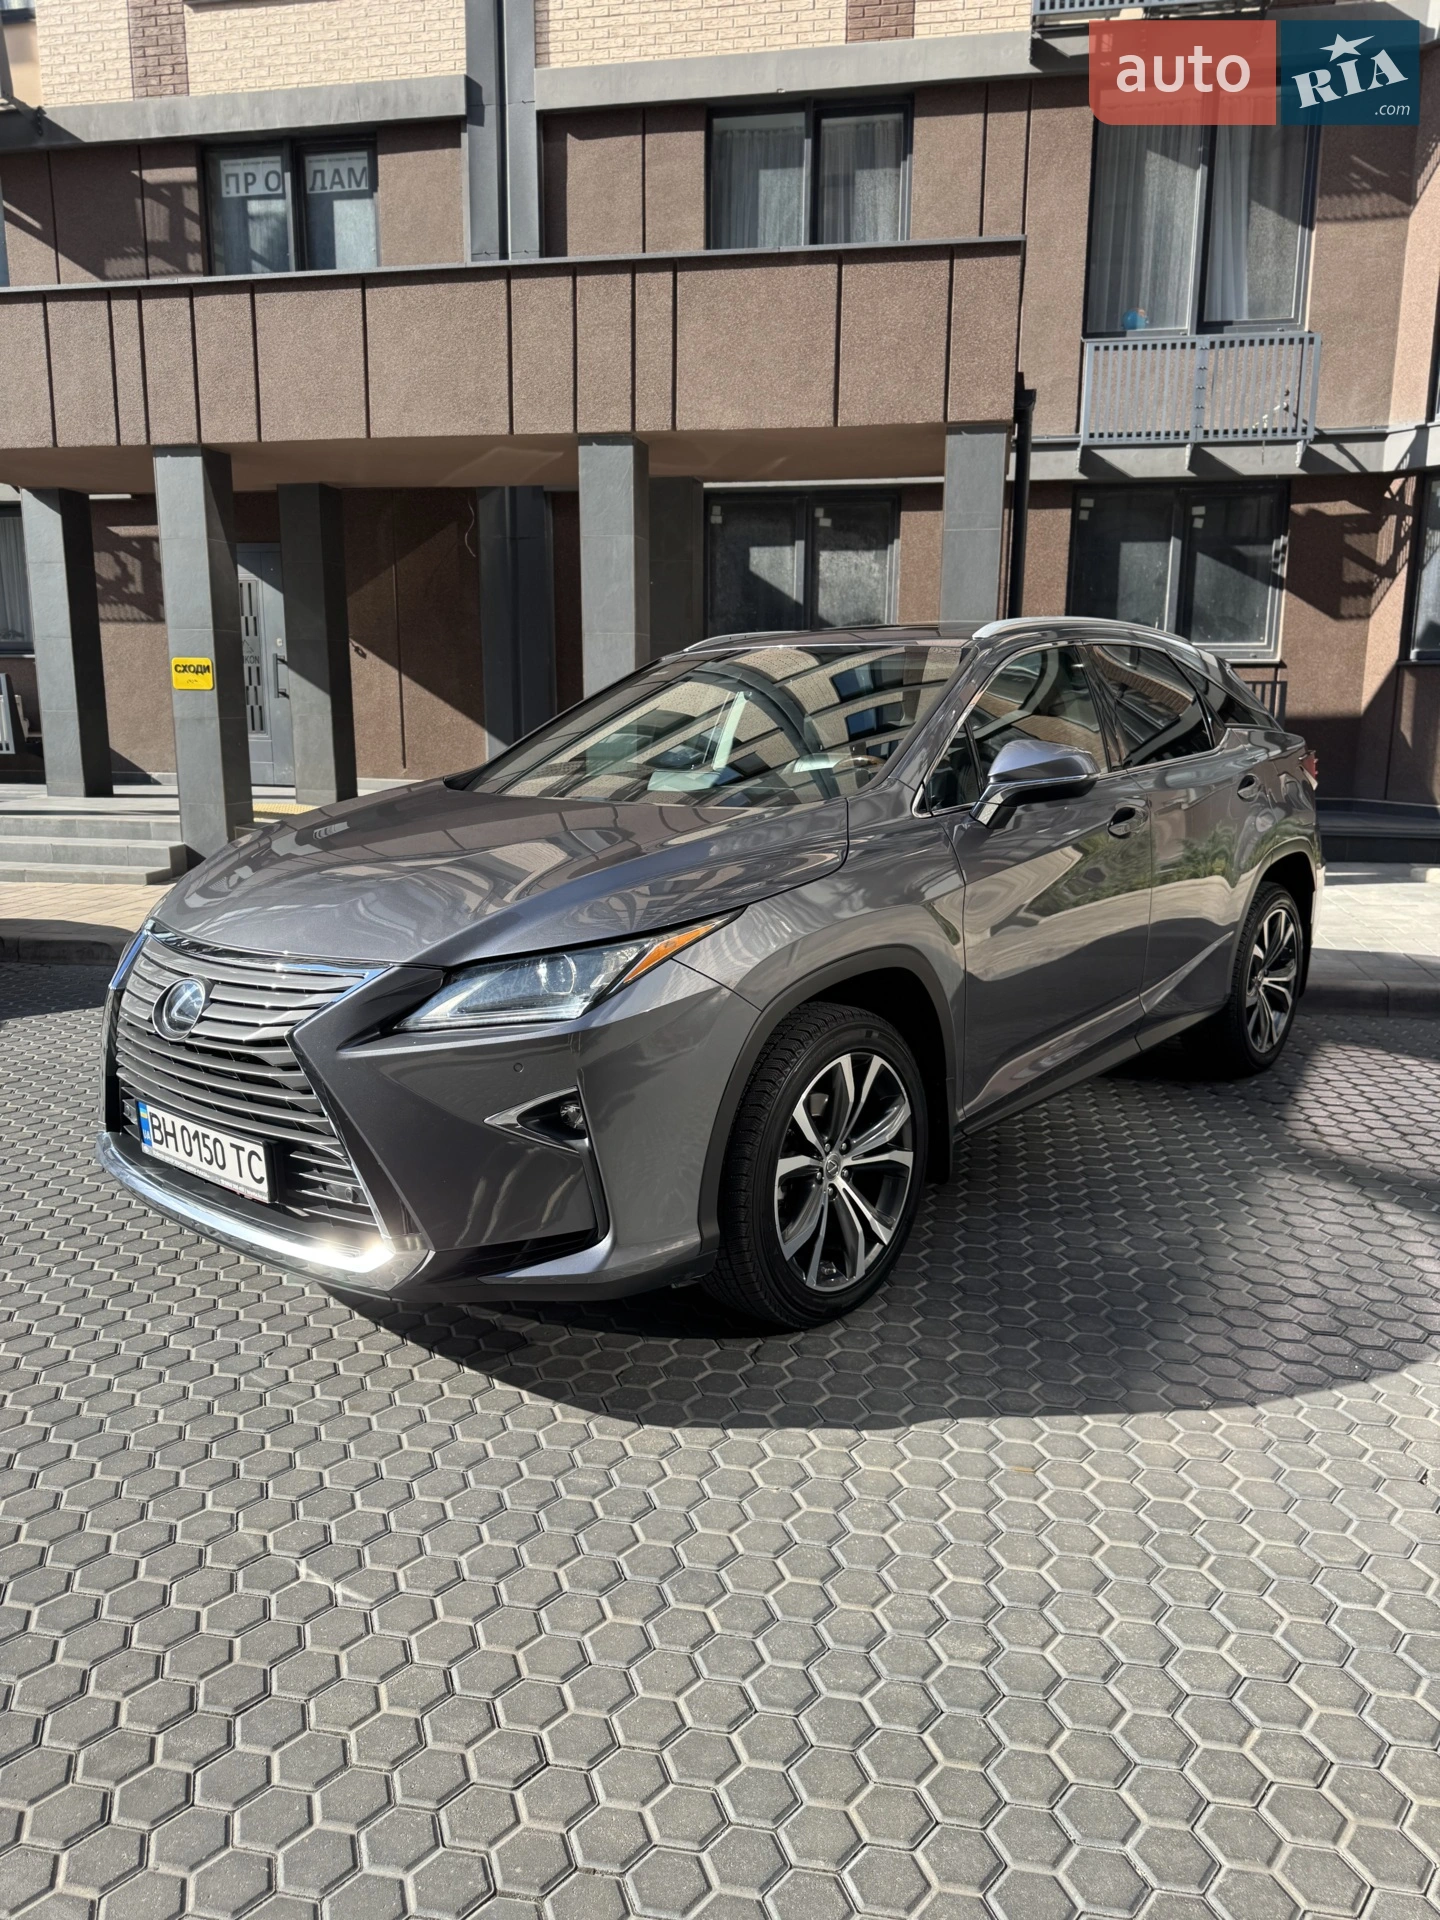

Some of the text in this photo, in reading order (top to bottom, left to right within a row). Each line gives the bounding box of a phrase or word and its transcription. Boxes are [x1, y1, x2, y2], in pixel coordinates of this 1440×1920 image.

[174, 663, 211, 676] СХОДИ
[149, 1111, 179, 1153] BH
[180, 1124, 227, 1171] 0150
[229, 1142, 265, 1185] TC
